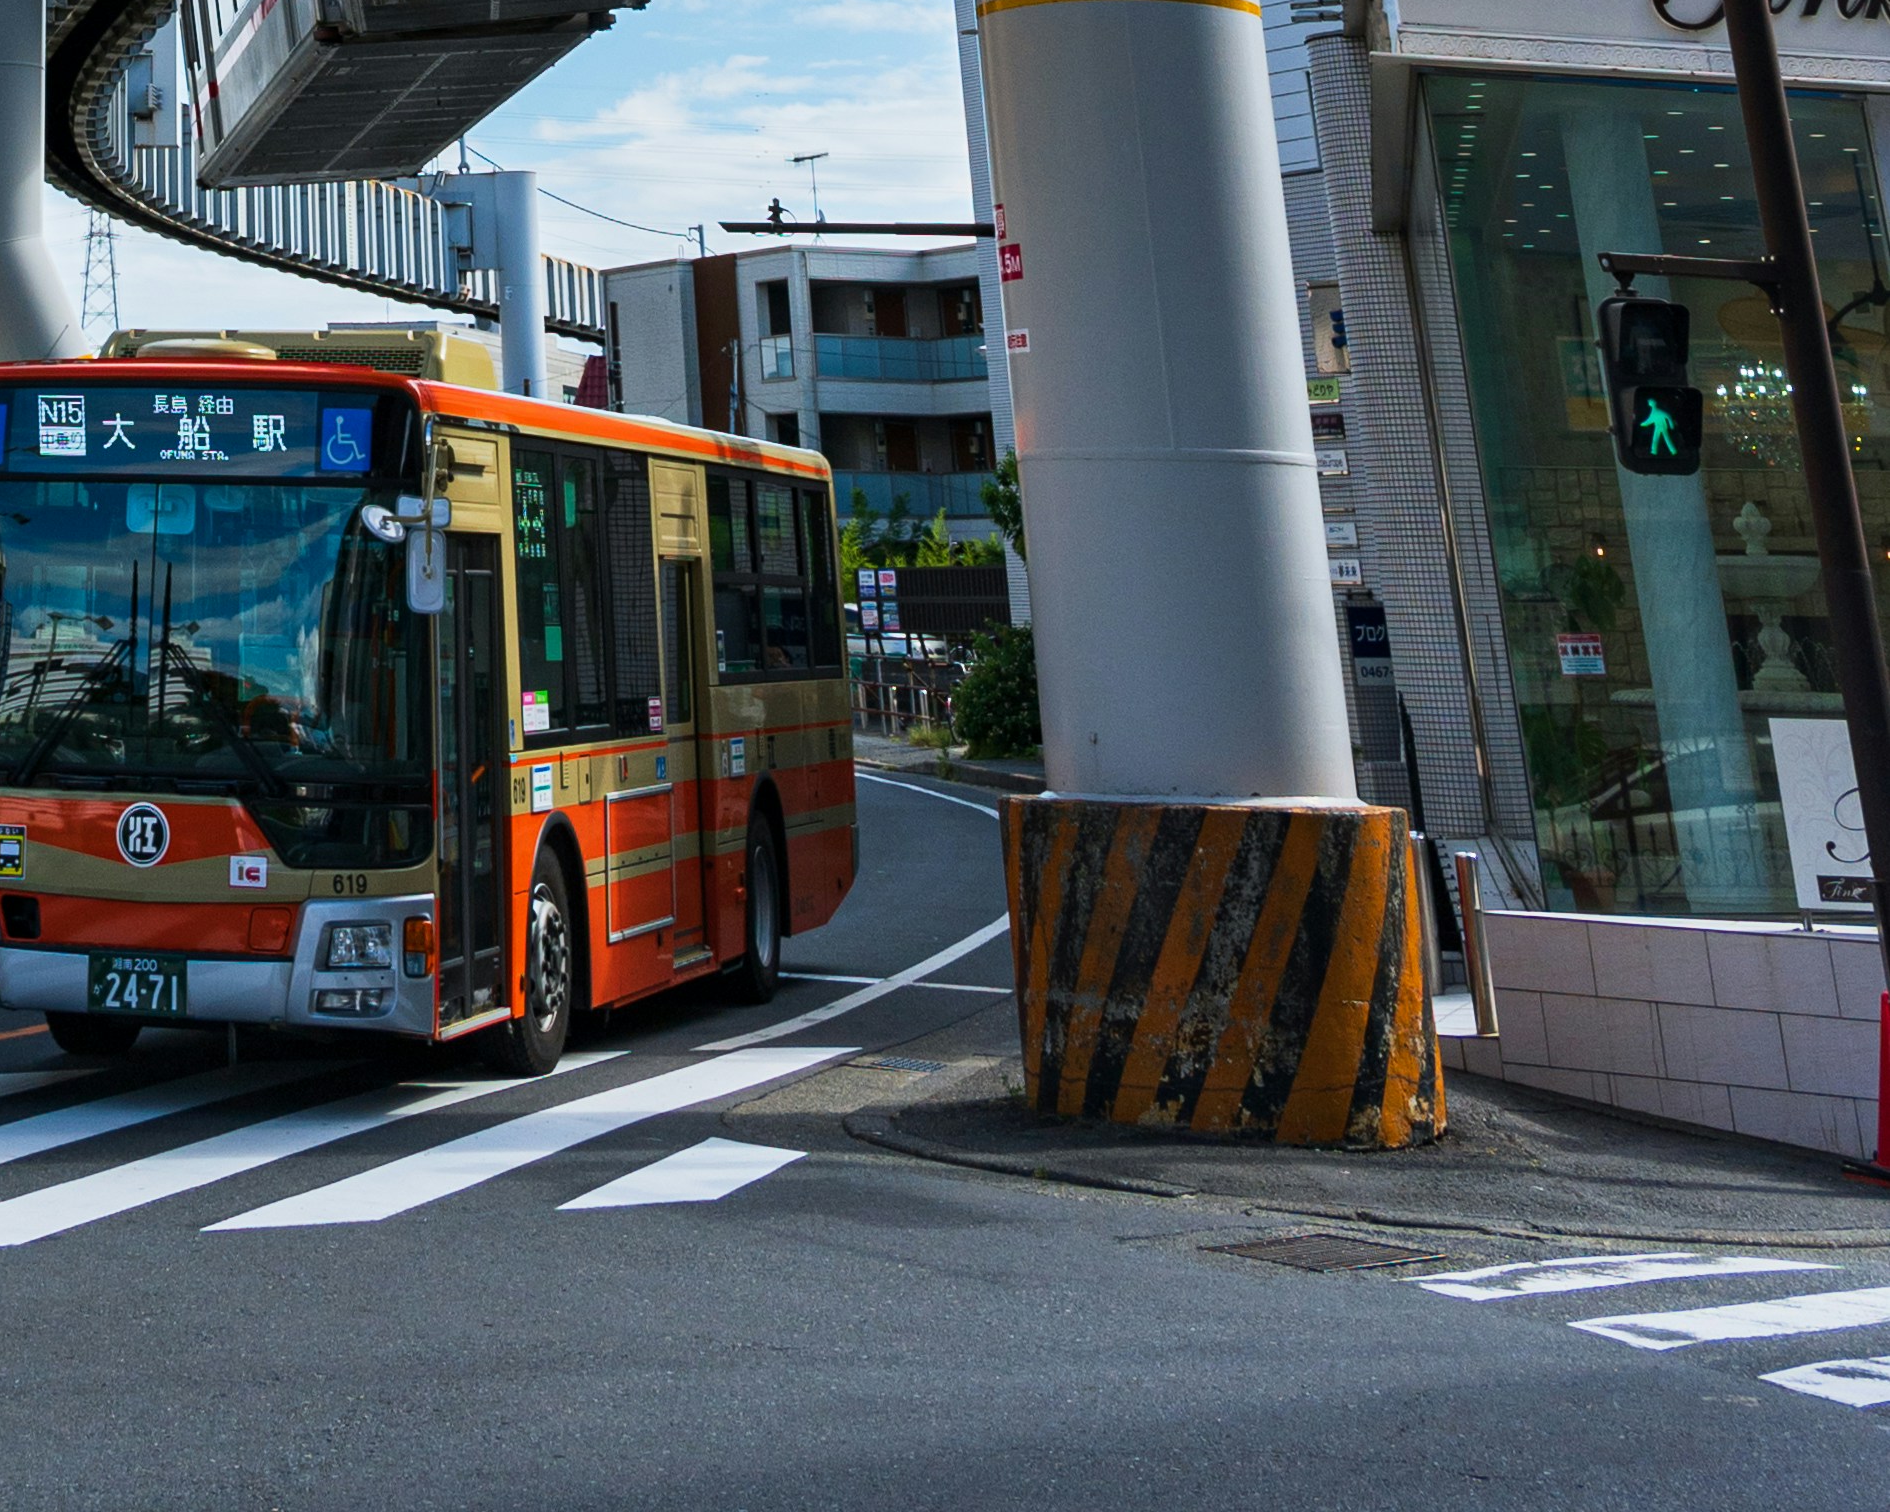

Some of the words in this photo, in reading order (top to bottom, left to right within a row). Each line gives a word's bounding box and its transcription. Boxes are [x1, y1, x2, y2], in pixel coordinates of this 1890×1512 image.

[41, 400, 83, 424] N15
[153, 394, 188, 414] 長島
[198, 394, 233, 414] 経由
[102, 413, 288, 453] 大船駅
[160, 449, 196, 461] OFUNA
[513, 776, 526, 805] 619
[332, 874, 368, 895] 619
[112, 957, 133, 971] 湘南
[134, 958, 158, 972] 200
[105, 972, 178, 1012] 24-71
